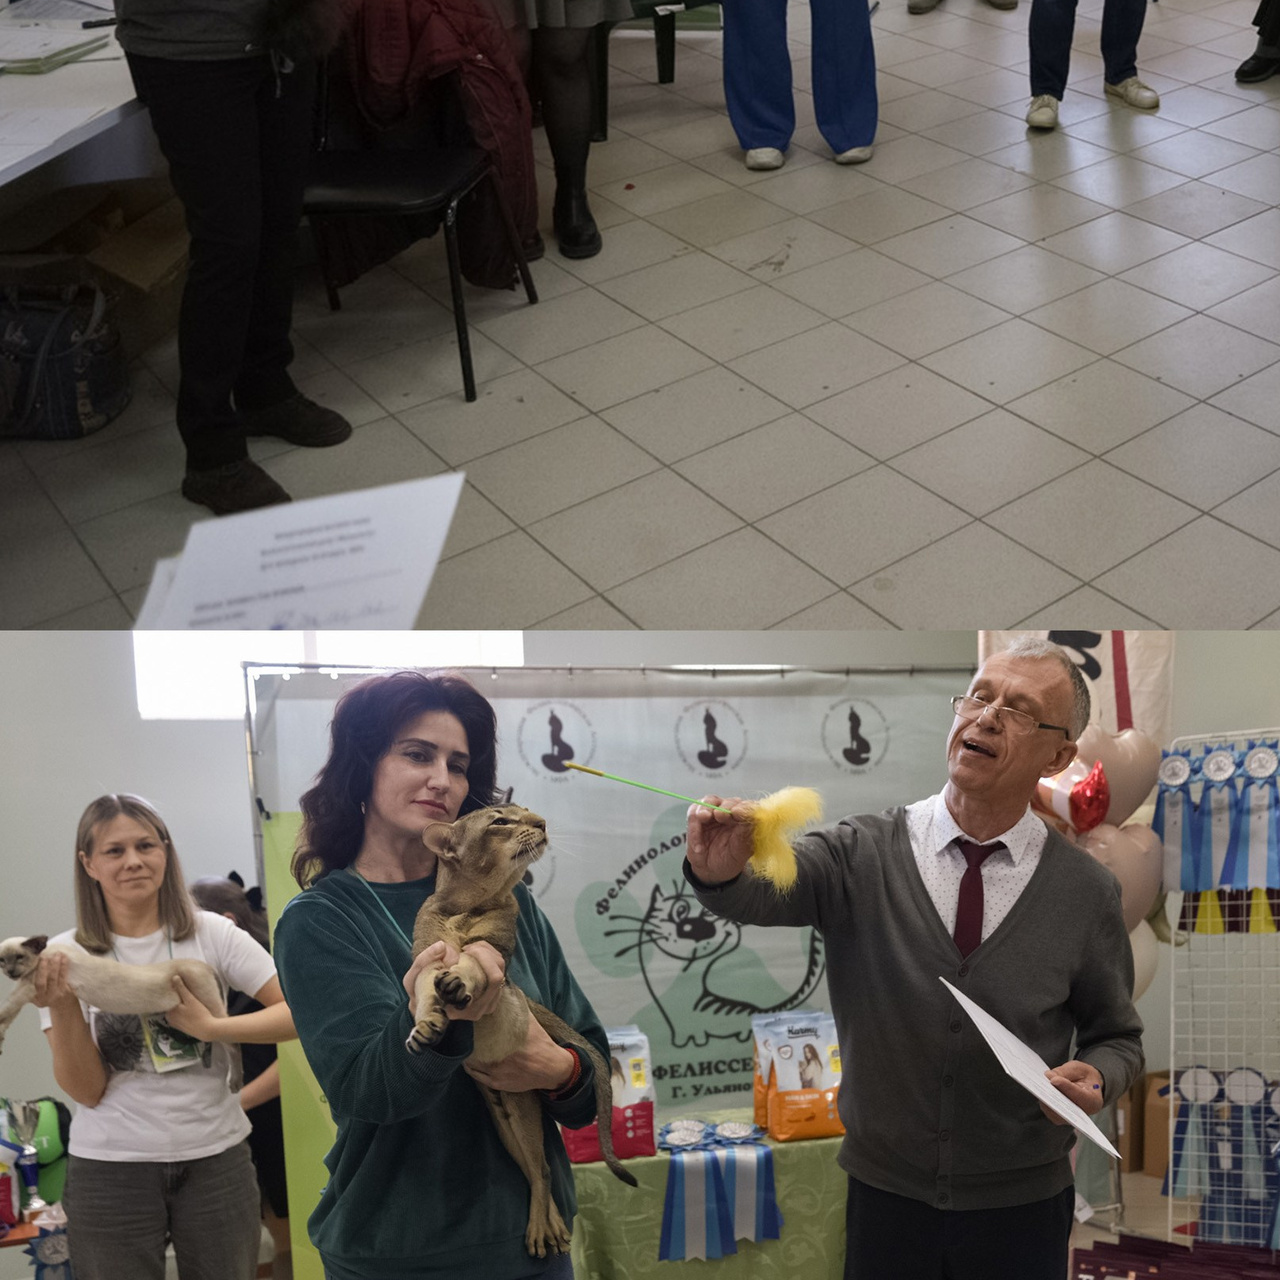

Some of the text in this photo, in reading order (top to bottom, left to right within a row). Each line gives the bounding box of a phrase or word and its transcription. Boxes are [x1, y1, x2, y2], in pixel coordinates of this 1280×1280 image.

[652, 1058, 754, 1081] ФЕЛИССЕ
[671, 1081, 754, 1099] Г. Ульяно
